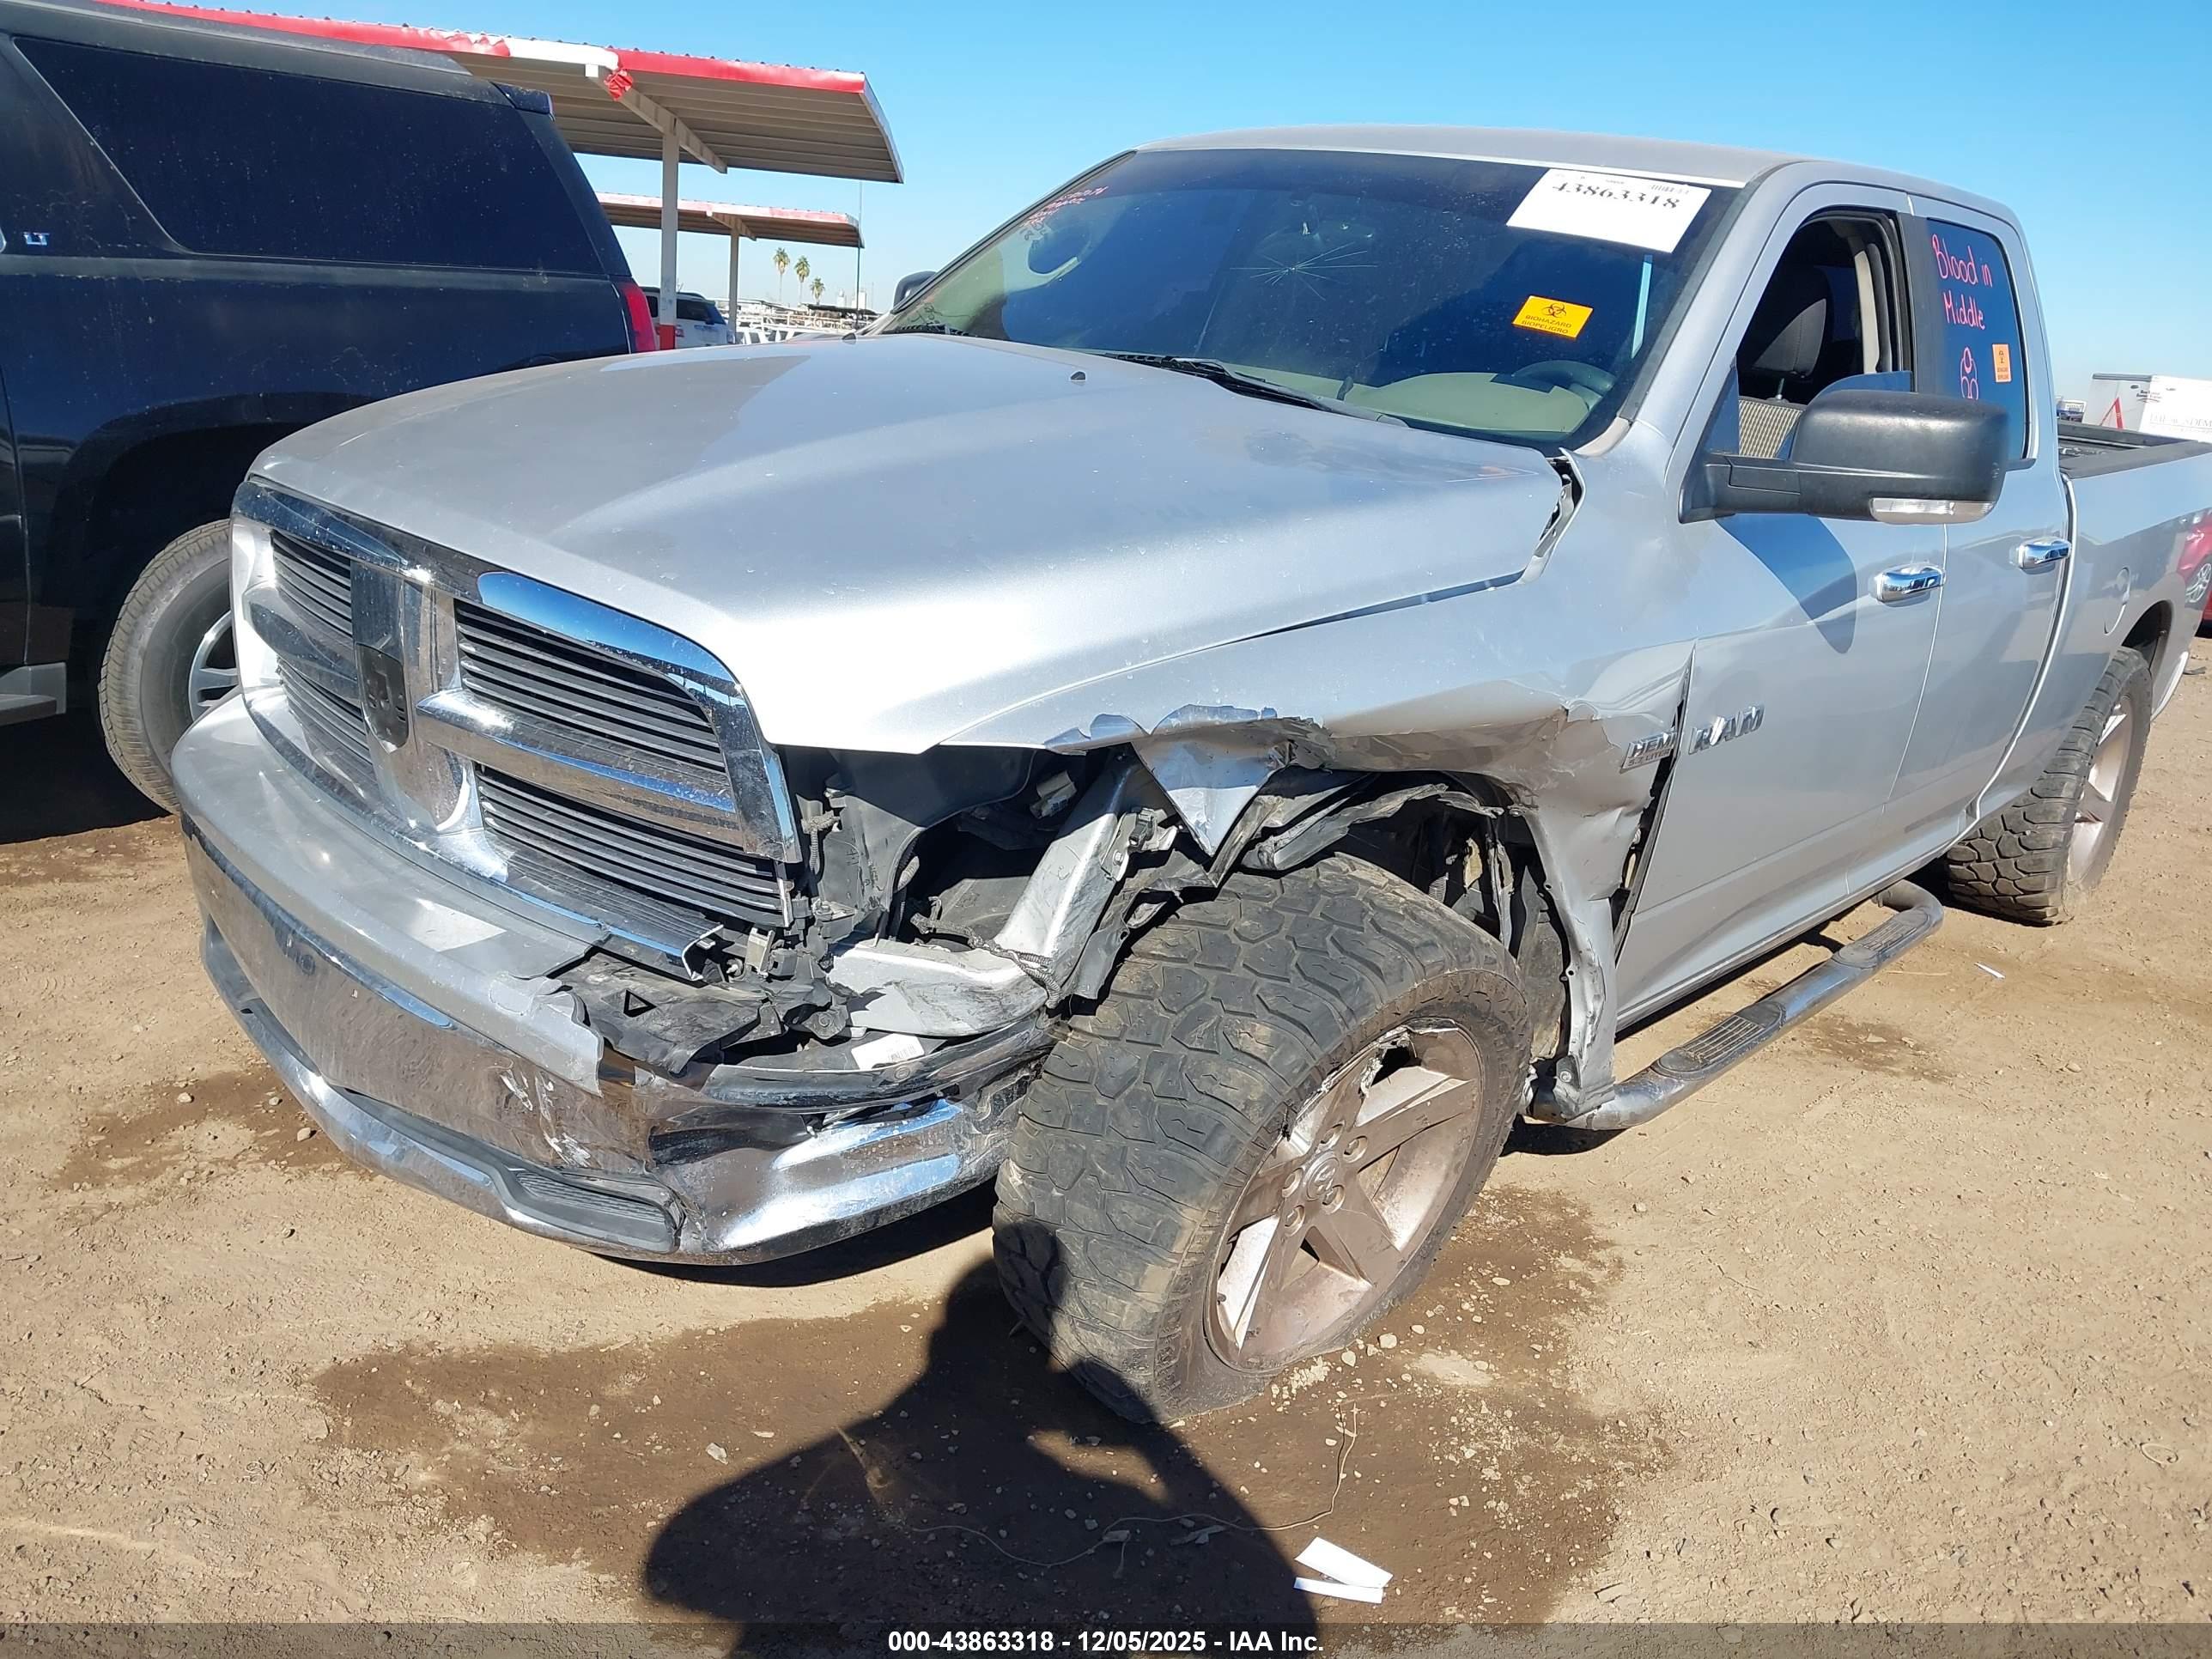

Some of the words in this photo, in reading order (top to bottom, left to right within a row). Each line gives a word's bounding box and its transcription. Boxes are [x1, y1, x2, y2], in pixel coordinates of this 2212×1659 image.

[1552, 181, 1680, 209] 43863318
[23, 231, 50, 246] LT
[1932, 234, 1978, 285] Blood
[1979, 258, 1993, 288] in
[1525, 314, 1572, 328] BIOHAZARD
[1942, 289, 1986, 330] Middle
[1521, 319, 1569, 334] BIOPELIGRO
[1688, 704, 1765, 756] RAM
